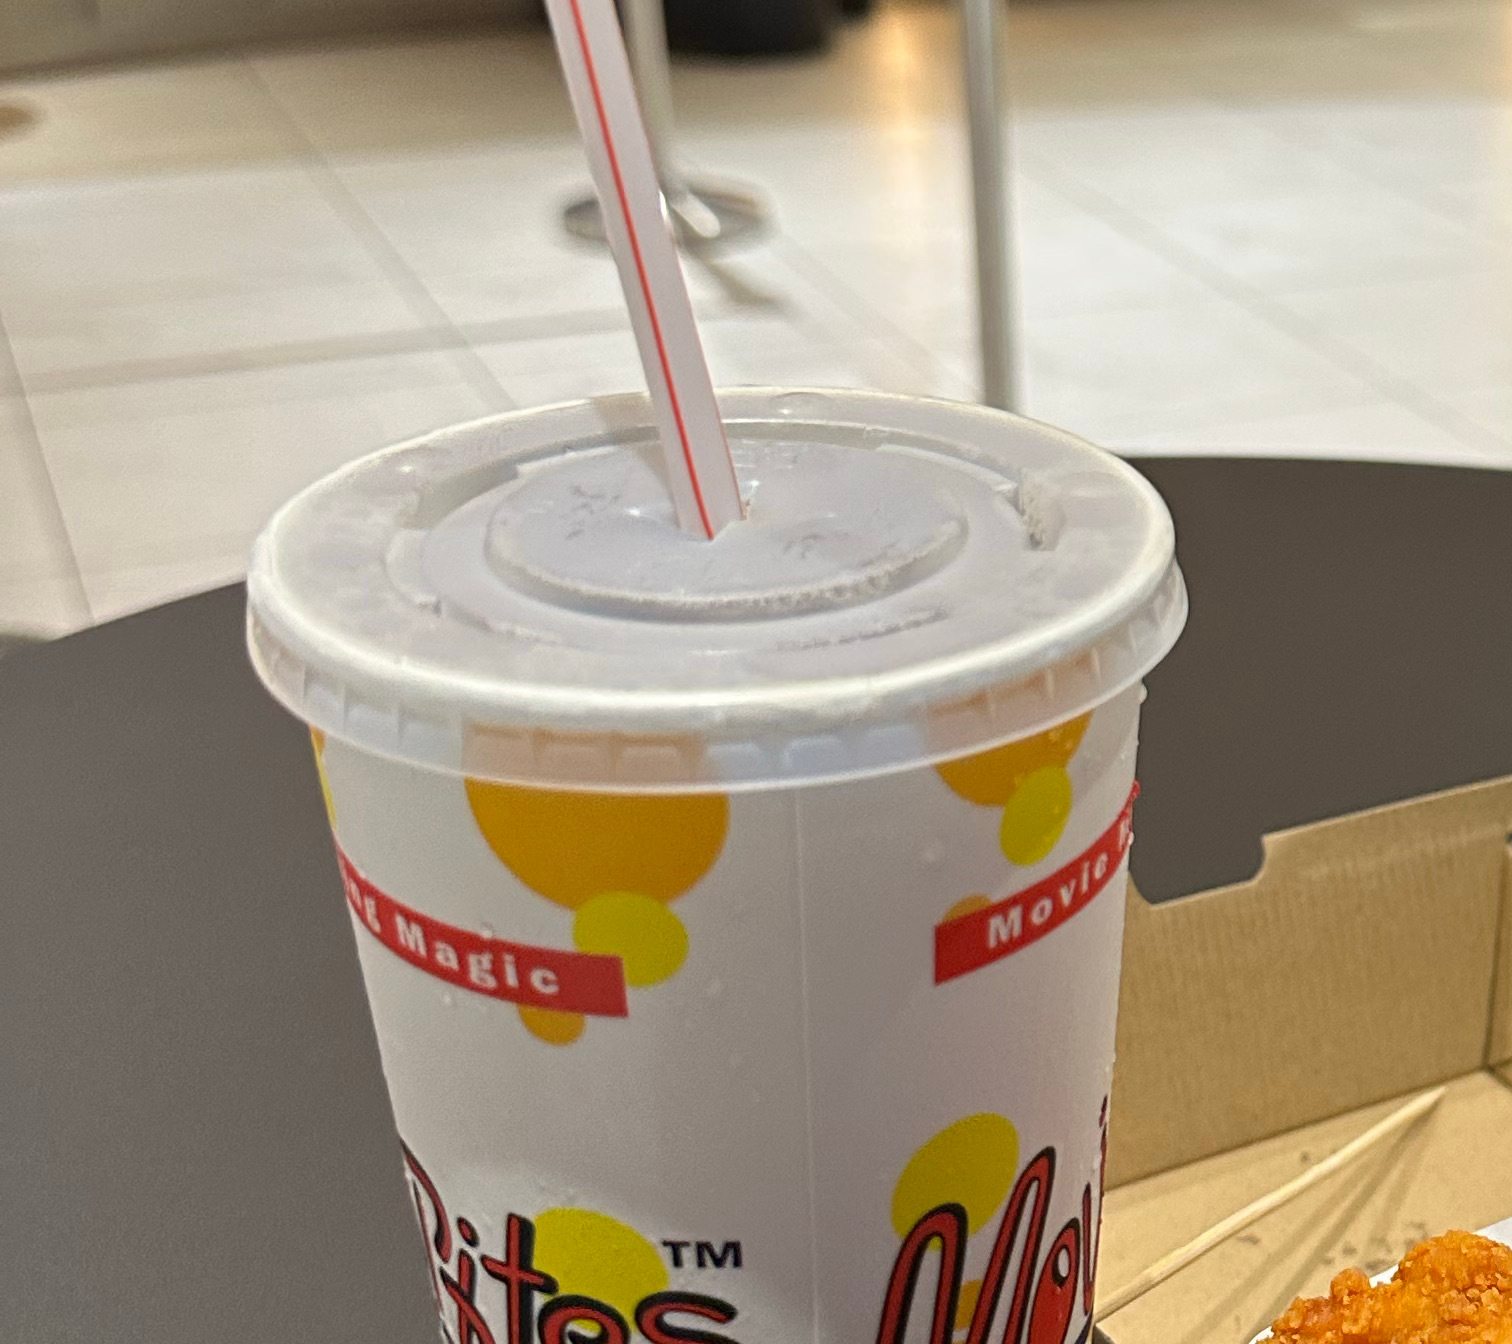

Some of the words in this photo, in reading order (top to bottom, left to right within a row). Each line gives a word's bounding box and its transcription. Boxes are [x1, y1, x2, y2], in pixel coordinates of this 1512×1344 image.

[986, 851, 1109, 950] Movie
[395, 913, 561, 994] Magic
[661, 1239, 744, 1270] TM
